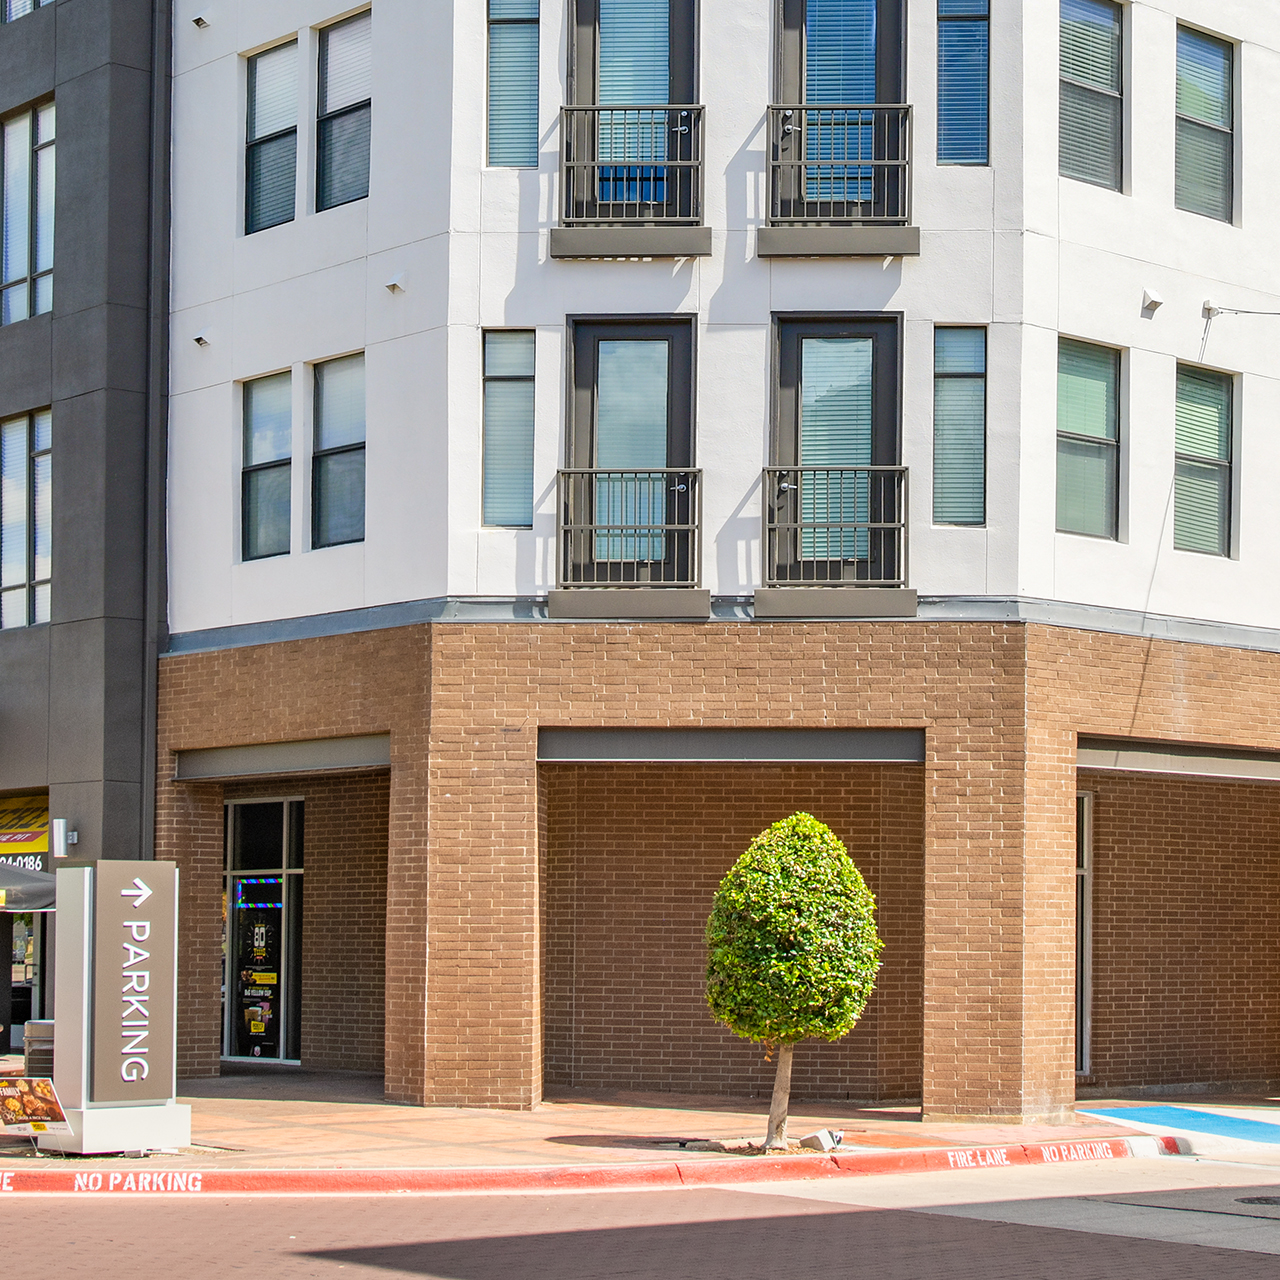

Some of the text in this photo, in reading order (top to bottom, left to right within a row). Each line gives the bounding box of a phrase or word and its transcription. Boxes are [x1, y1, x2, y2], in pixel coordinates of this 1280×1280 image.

[10, 833, 32, 841] PIT
[254, 926, 266, 947] 80
[121, 921, 150, 1082] PARKING
[0, 1087, 21, 1097] FAMILY
[947, 1142, 1114, 1168] FIRE LANE NO PARKING
[74, 1172, 102, 1191] NO
[109, 1172, 202, 1192] PARKING
